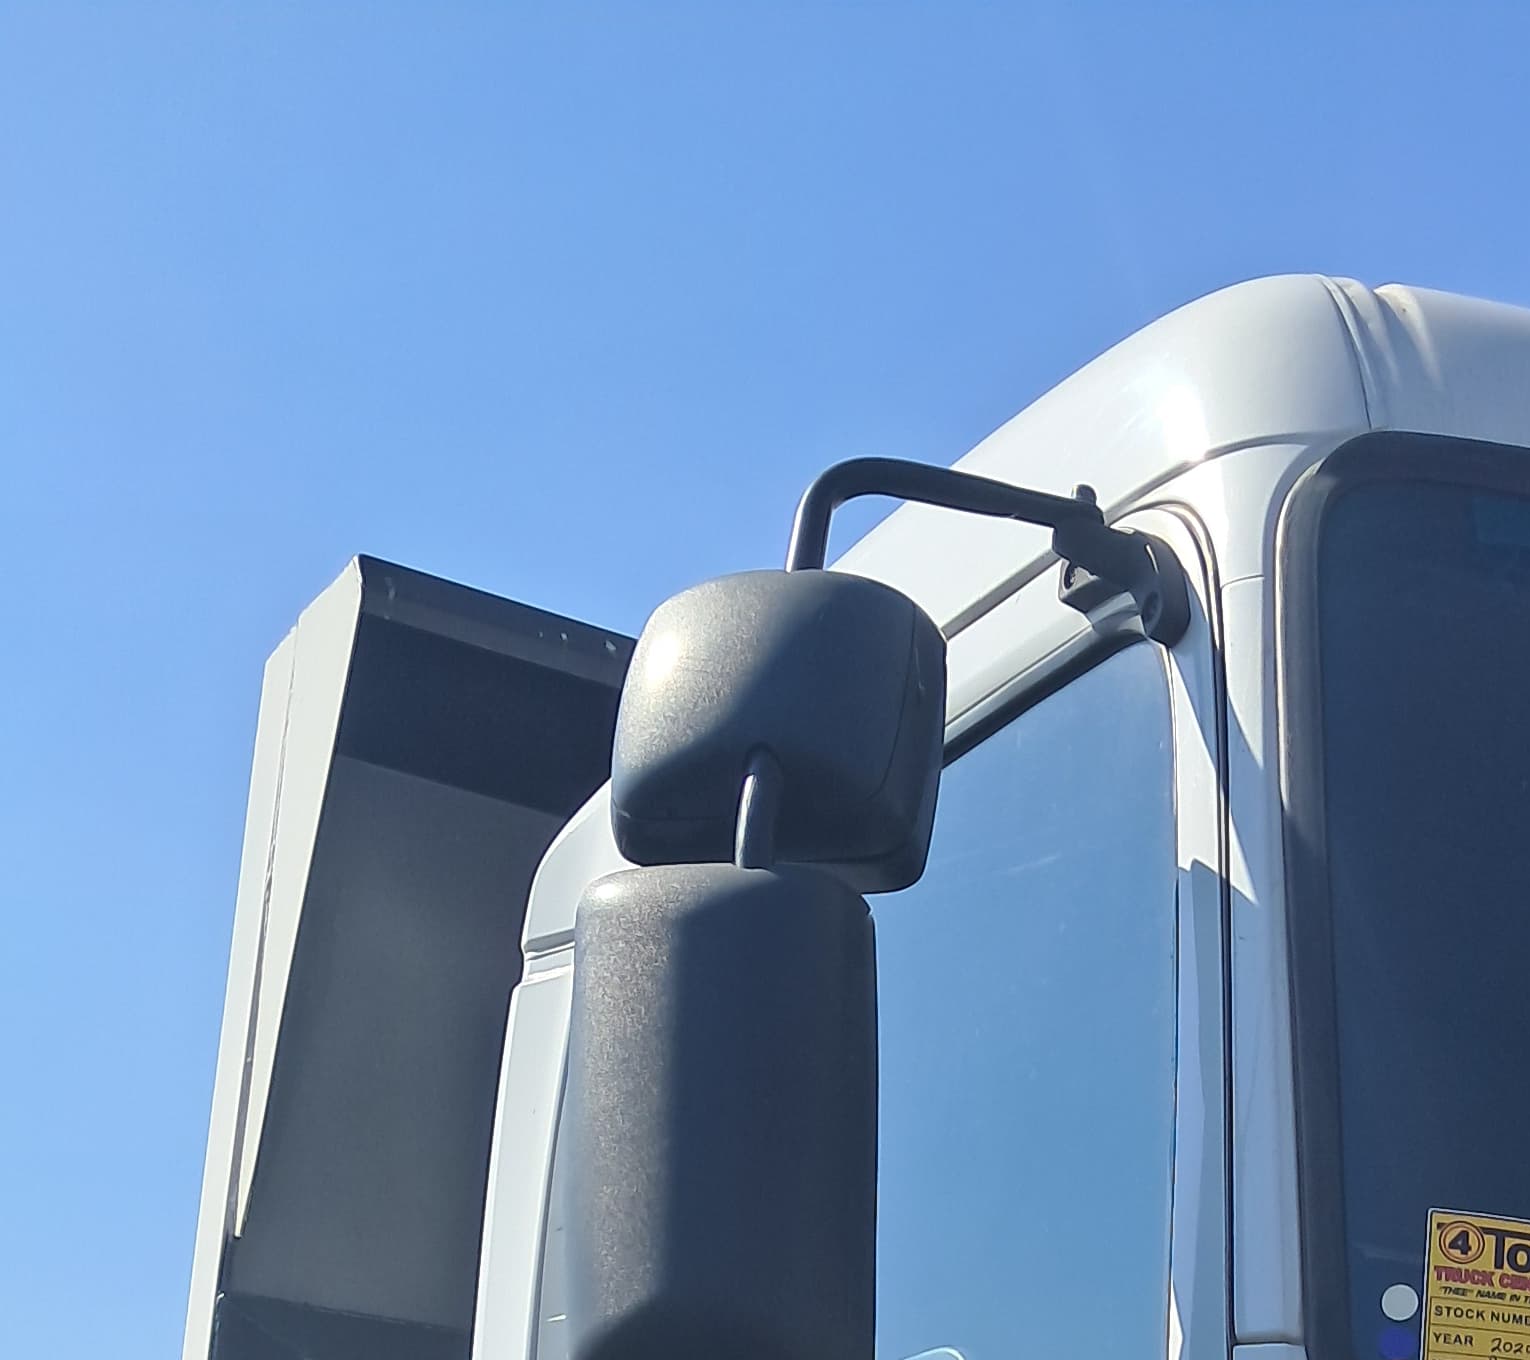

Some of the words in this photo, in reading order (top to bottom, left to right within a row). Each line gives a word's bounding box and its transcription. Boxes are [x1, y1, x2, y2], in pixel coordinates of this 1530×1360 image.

[1434, 1265, 1495, 1287] TRUCK
[1475, 1290, 1507, 1302] NAME
[1509, 1294, 1521, 1304] IN
[1434, 1305, 1486, 1321] STOCK
[1433, 1332, 1474, 1347] YEAR
